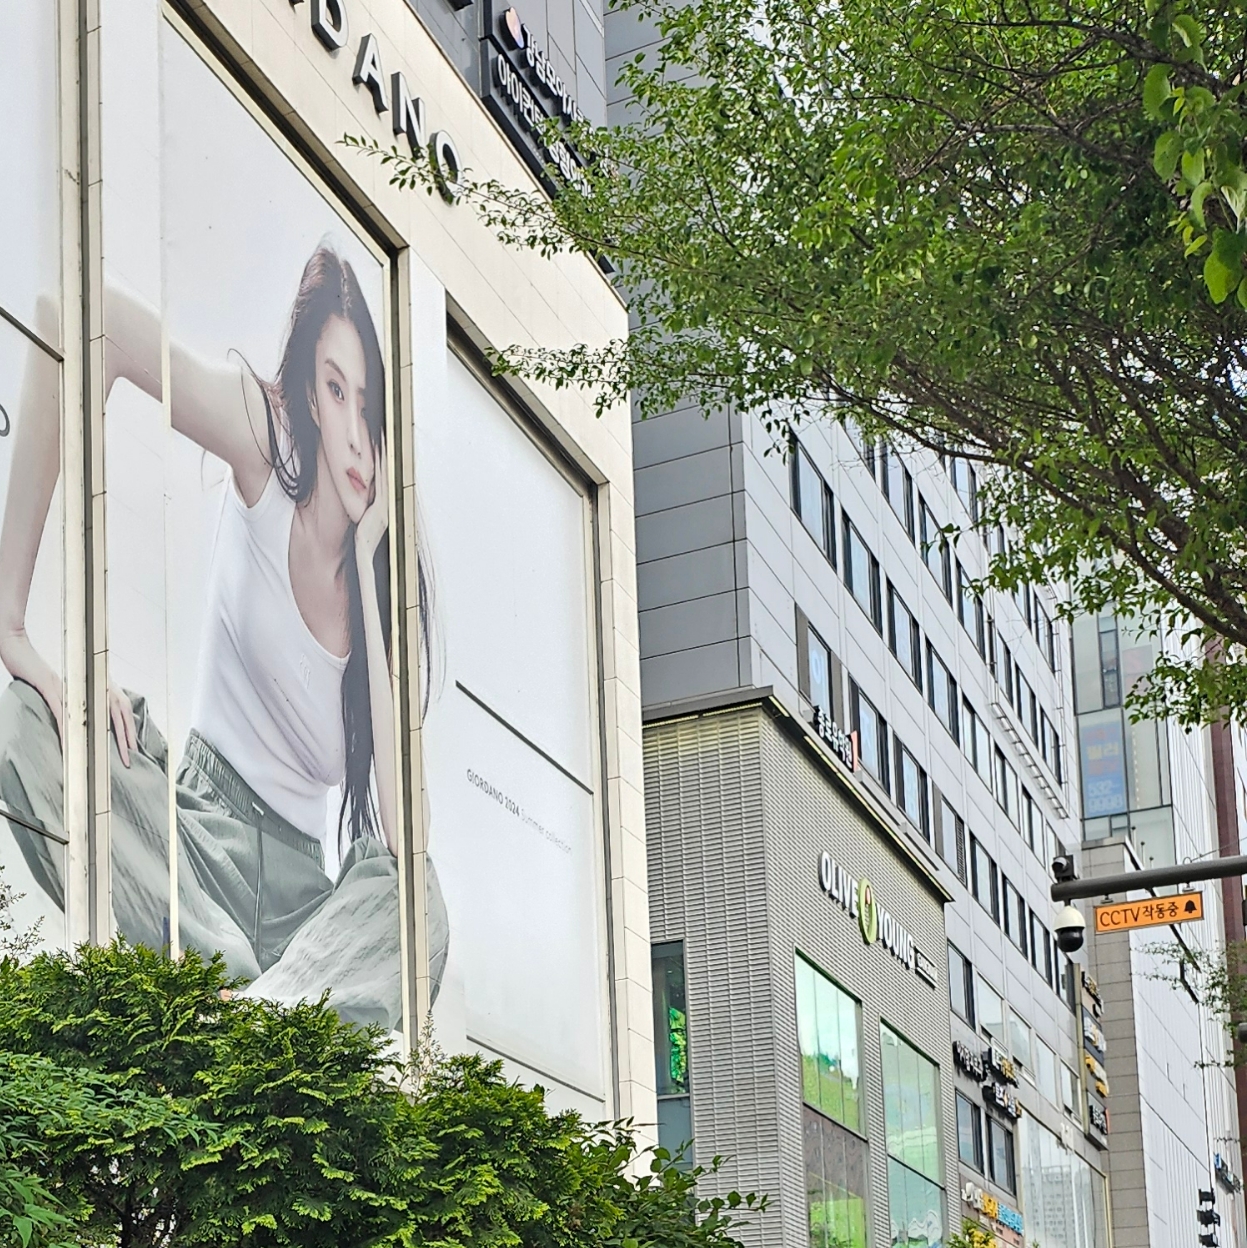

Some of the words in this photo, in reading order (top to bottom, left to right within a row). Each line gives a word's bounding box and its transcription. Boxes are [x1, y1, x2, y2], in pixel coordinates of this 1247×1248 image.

[292, 0, 463, 204] DANO
[818, 704, 853, 769] 종로유학원
[466, 768, 504, 805] GIORDANO
[504, 796, 520, 817] 2024
[820, 850, 859, 918] OLIVE
[876, 902, 914, 970] YOUNG
